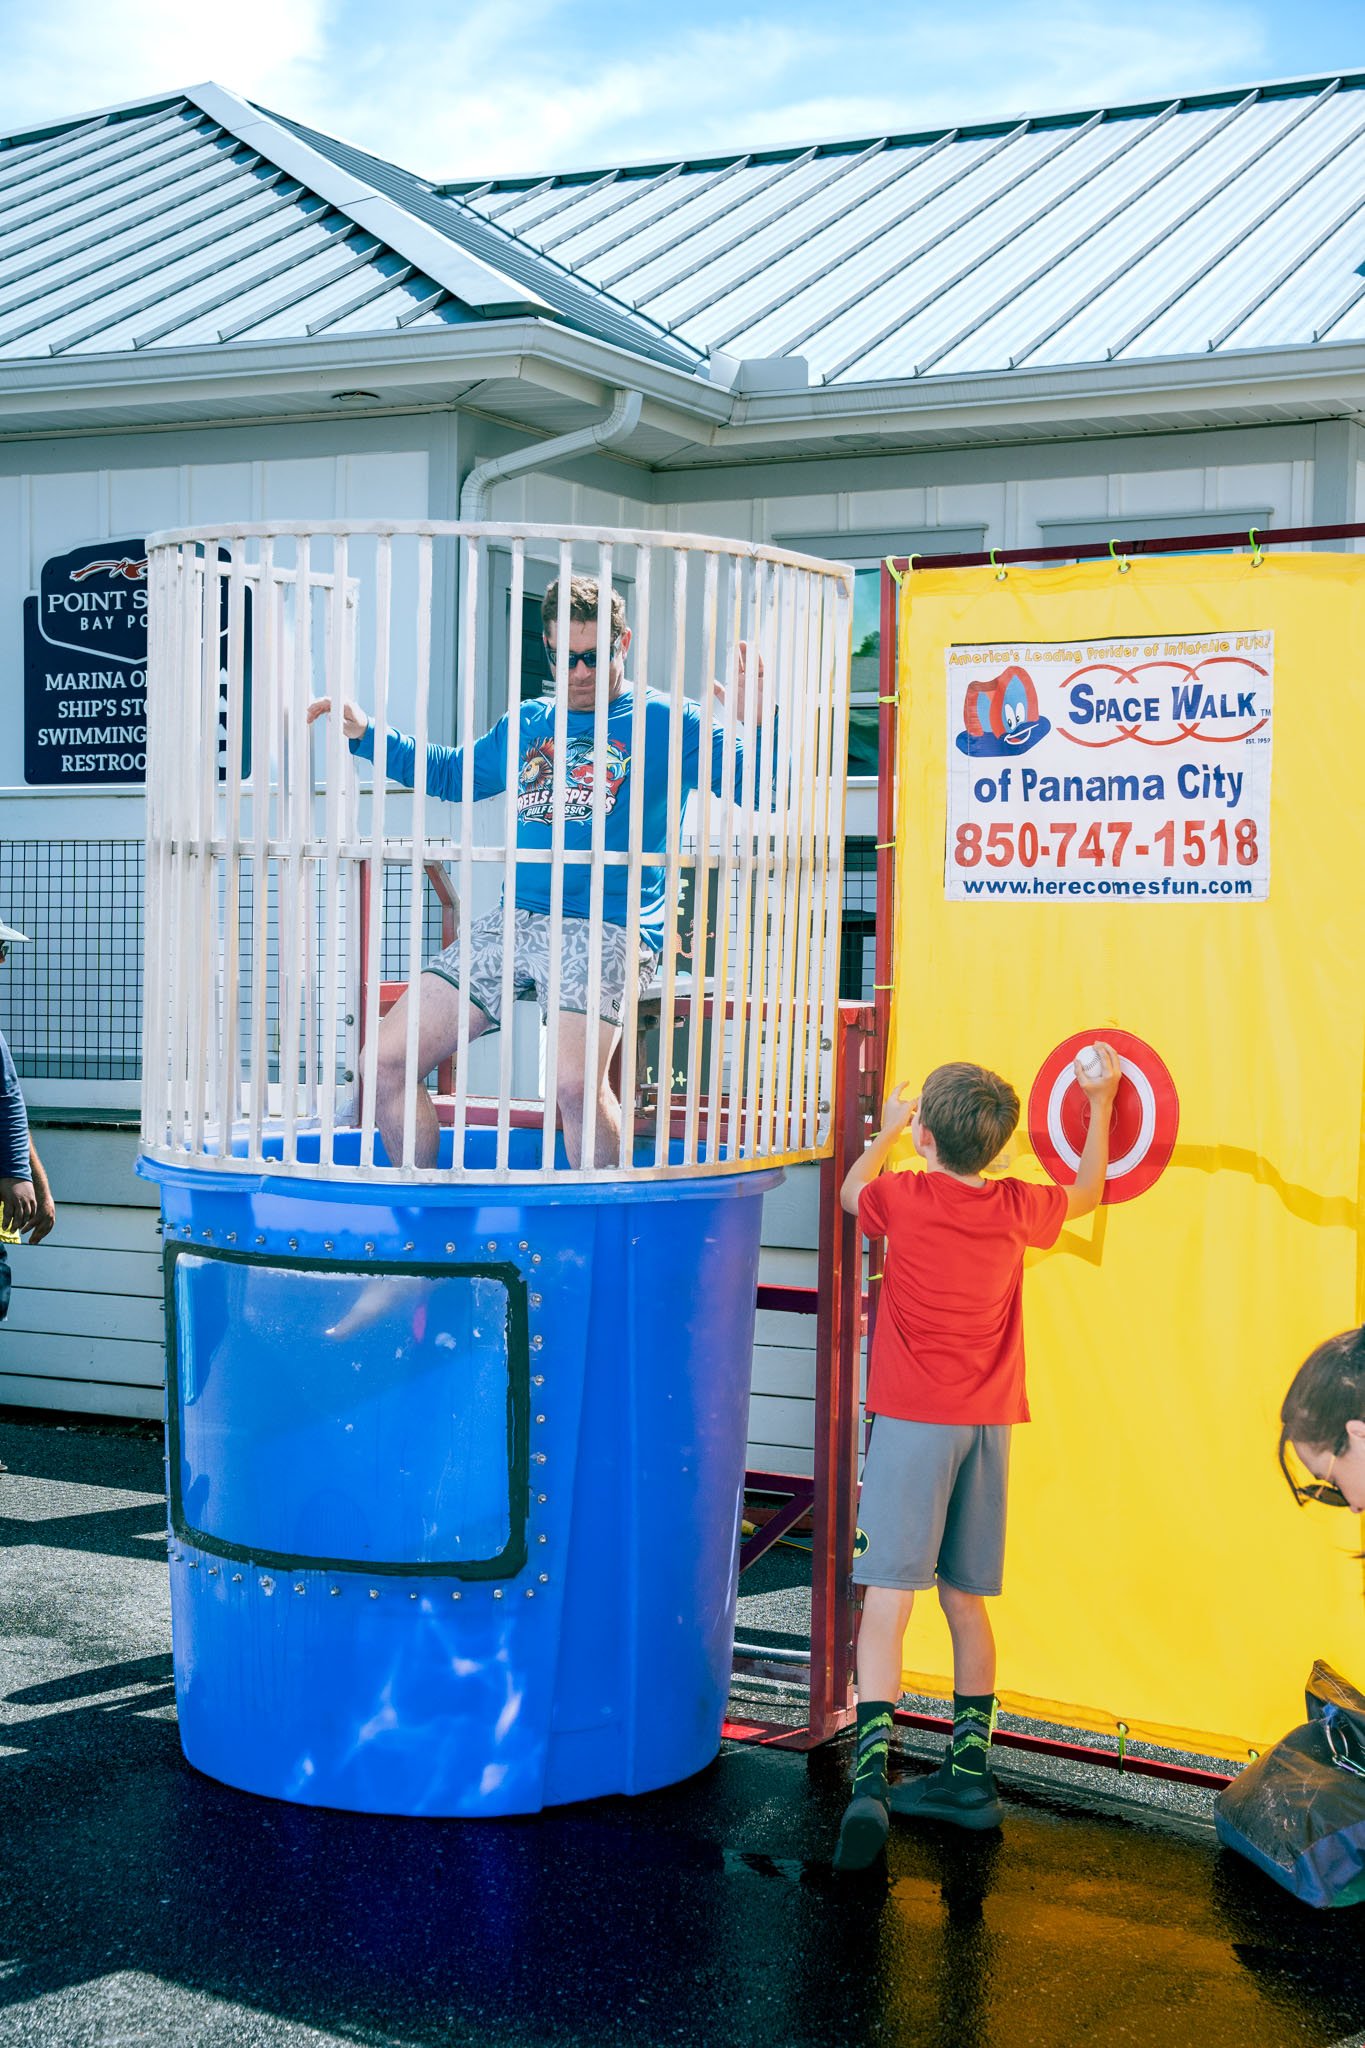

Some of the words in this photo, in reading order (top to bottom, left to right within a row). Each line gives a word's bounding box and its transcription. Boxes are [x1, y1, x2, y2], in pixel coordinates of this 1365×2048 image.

[47, 590, 127, 613] POINT
[80, 615, 115, 631] BAY
[127, 613, 148, 629] PO
[949, 648, 1020, 665] America's
[1024, 648, 1083, 663] Leading
[1087, 644, 1139, 660] Provider
[1143, 642, 1160, 657] of
[1164, 639, 1230, 656] Inflatable
[45, 671, 127, 691] MARINA
[58, 699, 117, 718] SHIP'S
[121, 698, 147, 716] ST
[1068, 683, 1160, 725] SPACE
[1171, 683, 1257, 721] WALK
[37, 725, 147, 746] SWIMMING
[61, 752, 147, 773] RESTROO
[974, 768, 1011, 803] of
[1022, 768, 1165, 803] Panama
[1177, 763, 1244, 808] City
[526, 805, 547, 817] GULF
[547, 805, 586, 816] CSSIC
[564, 788, 616, 813] SPEAS
[954, 818, 1259, 868] 850-747-1518
[963, 876, 1252, 895] www.herecomesfun.com
